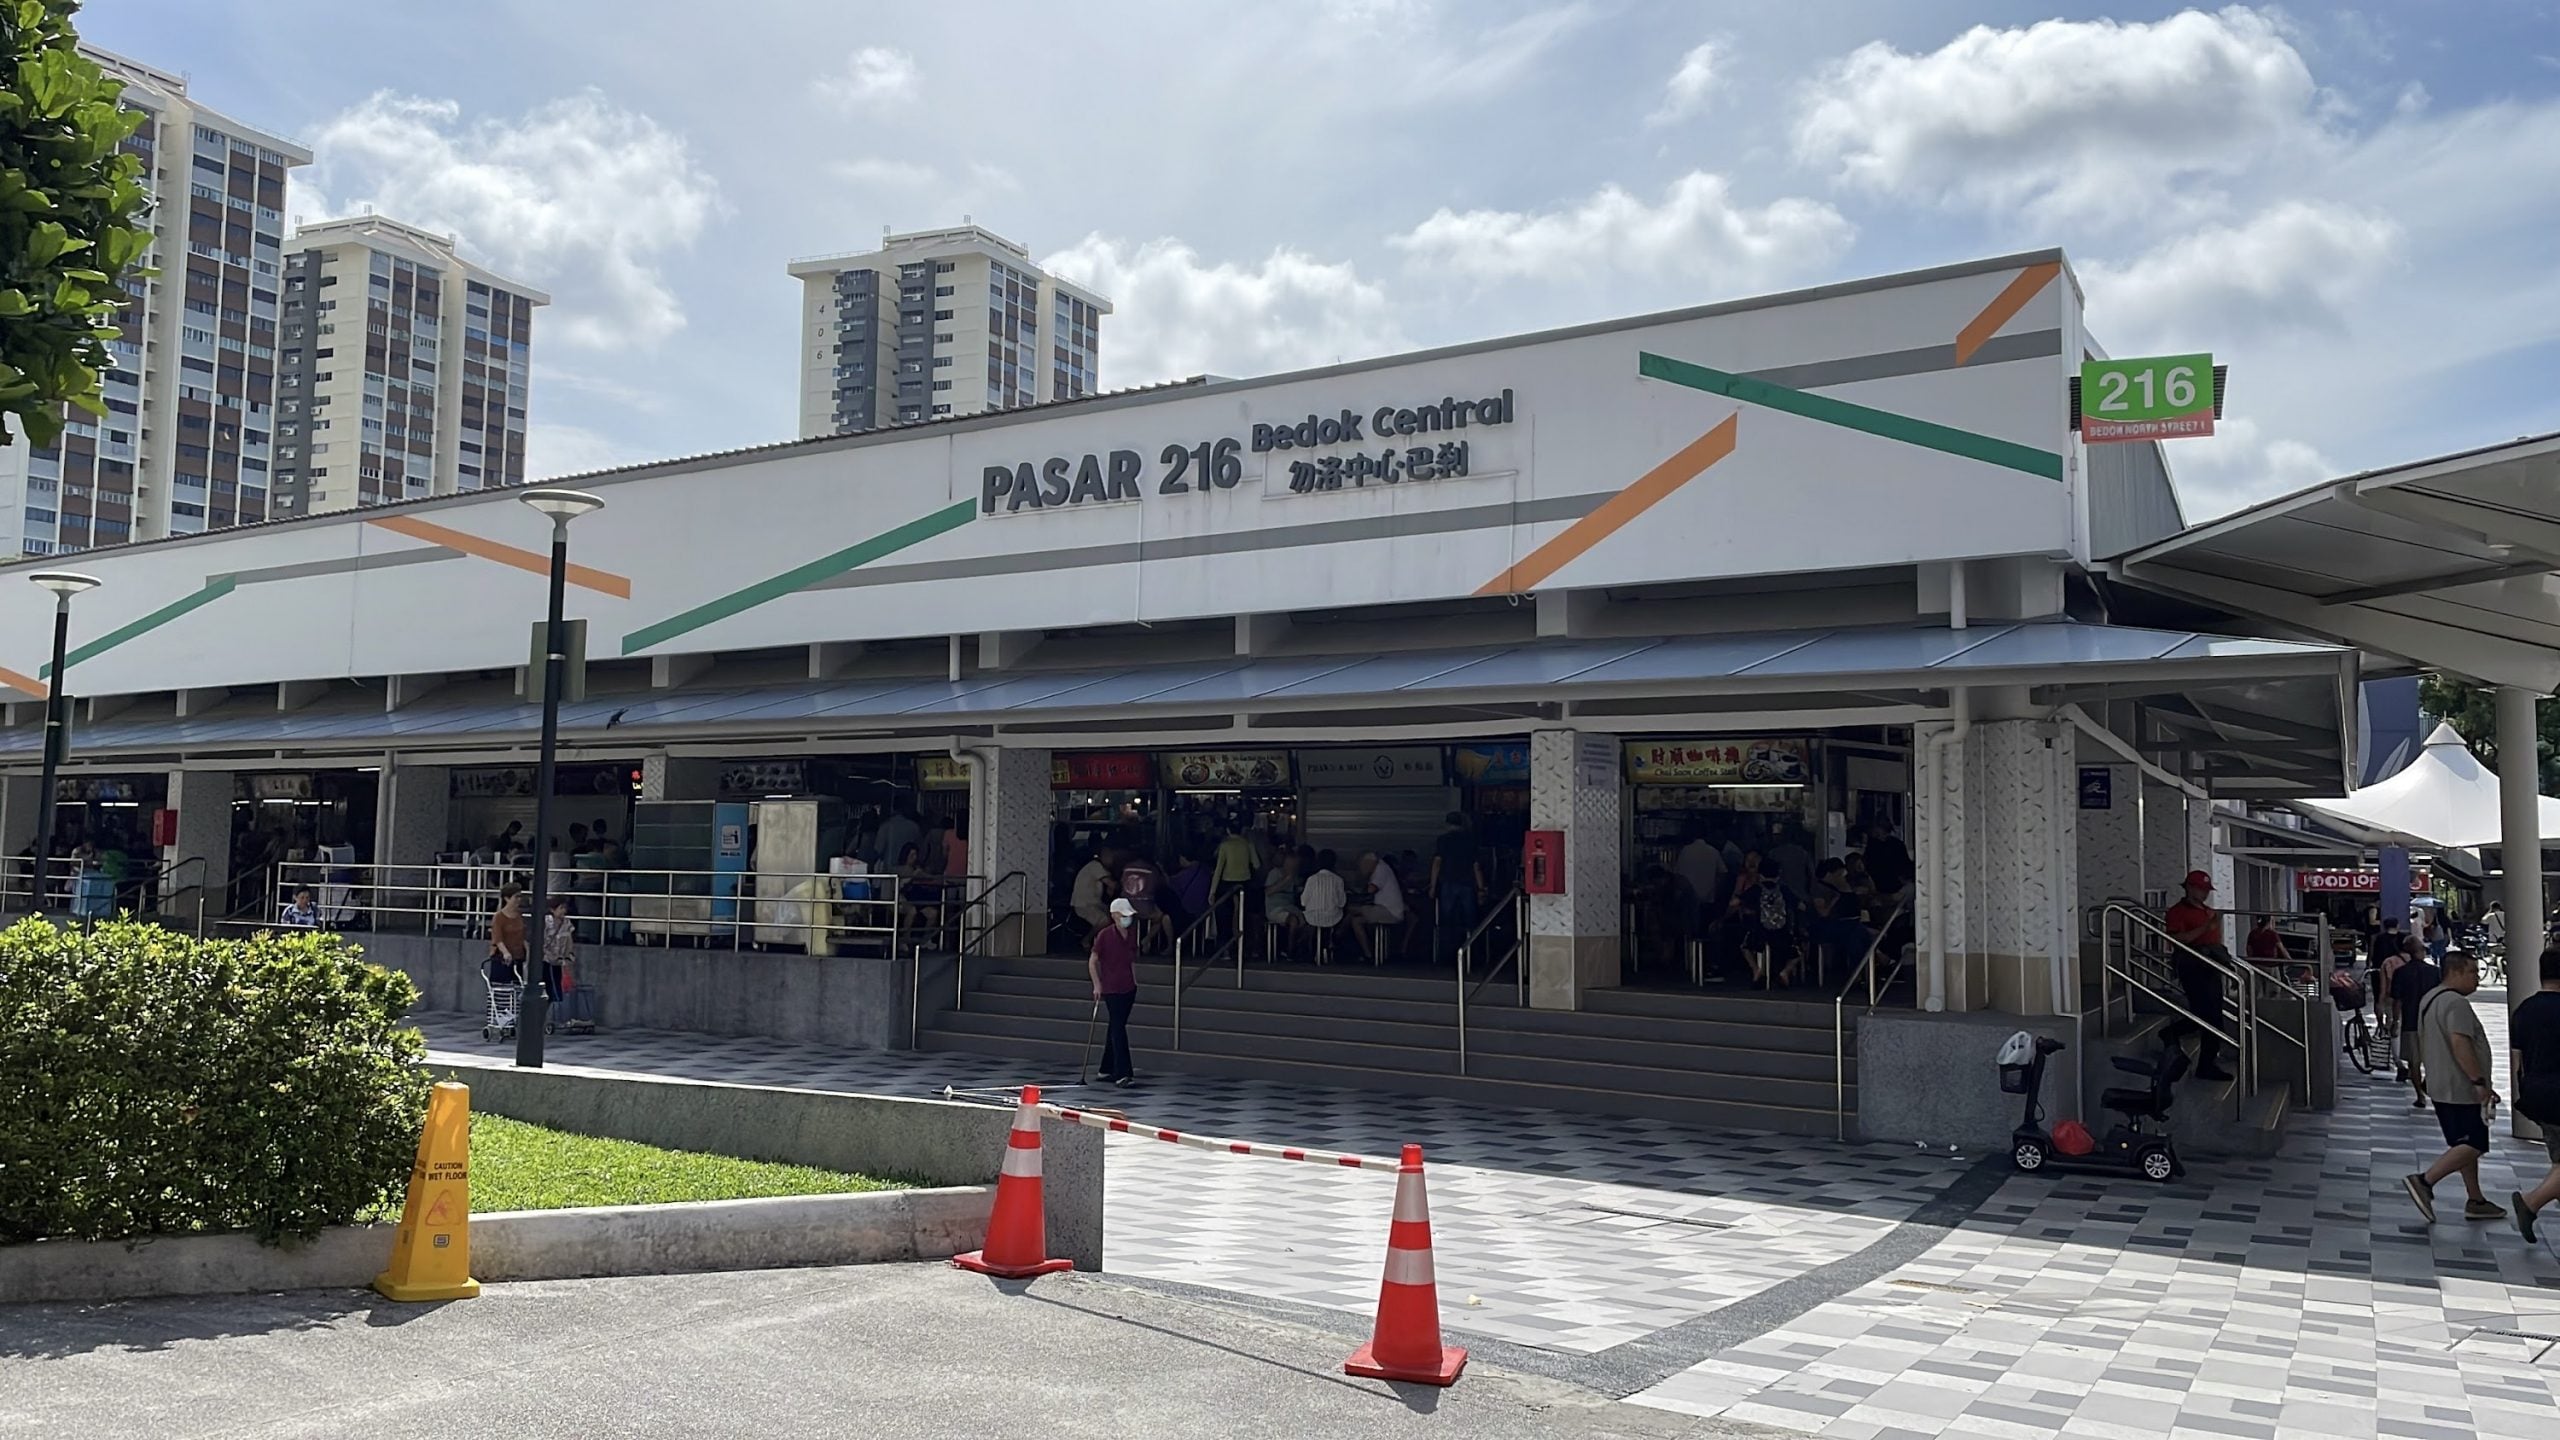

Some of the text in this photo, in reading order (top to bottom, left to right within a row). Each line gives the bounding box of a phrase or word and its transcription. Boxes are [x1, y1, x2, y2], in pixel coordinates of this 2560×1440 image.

[817, 304, 825, 360] 406
[2099, 366, 2196, 411] 216
[1251, 389, 1513, 453] Bedok Central
[2090, 426, 2124, 437] BEDOK
[2125, 423, 2159, 435] NORTH
[2161, 422, 2198, 433] STREET
[981, 437, 1242, 514] PASAR 216
[1288, 440, 1469, 494] 勿洛中心巴刹
[1673, 768, 1692, 776] Soon
[1693, 767, 1718, 777] Coffee
[2352, 874, 2380, 888] LOF
[428, 1171, 467, 1181] WET FLOOR
[434, 1162, 463, 1170] CAUTION
